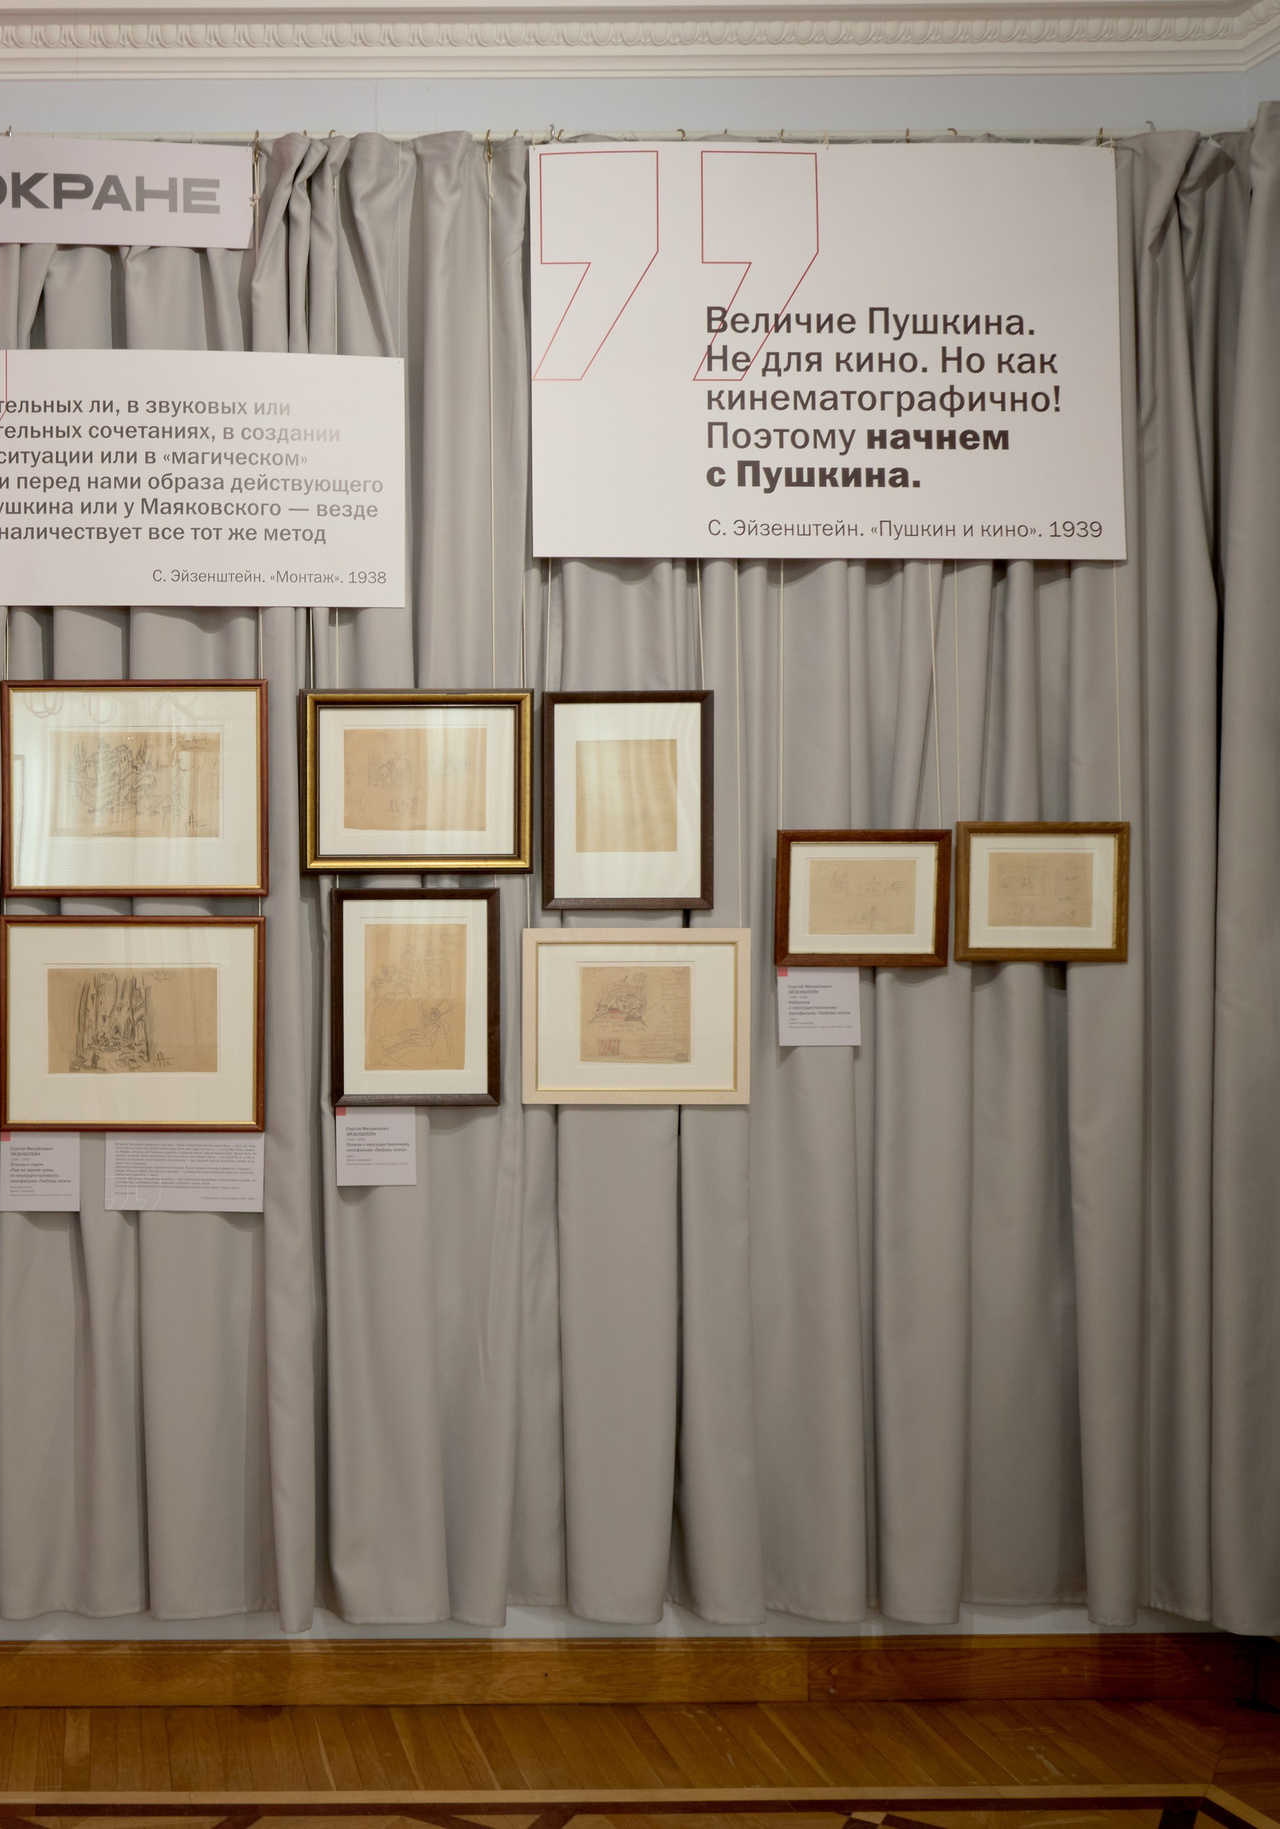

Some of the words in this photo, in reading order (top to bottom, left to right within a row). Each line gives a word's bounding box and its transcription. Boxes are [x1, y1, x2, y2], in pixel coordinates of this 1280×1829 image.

[706, 305, 857, 335] Величие
[868, 306, 1035, 342] Пушкина.
[706, 344, 752, 373] Не
[761, 351, 823, 378] для
[835, 351, 928, 374] кино.
[941, 345, 986, 374] Но
[997, 352, 1059, 375] как
[88, 399, 120, 417] ли,
[127, 400, 140, 414] в
[145, 400, 248, 418] звуковых
[254, 401, 290, 416] или
[706, 384, 1061, 419] кинематографично!
[88, 425, 216, 443] сочетаниях,
[223, 426, 235, 440] в
[240, 426, 340, 445] создании
[707, 421, 857, 457] Поэтому
[866, 428, 1010, 451] начнем
[100, 450, 138, 465] или
[144, 451, 157, 465] в
[16, 475, 81, 494] перед
[87, 475, 141, 490] нами
[147, 472, 225, 494] образа
[230, 473, 384, 496] действующего
[705, 466, 727, 488] с
[736, 459, 921, 495] Пушкина.
[80, 501, 118, 515] или
[123, 501, 135, 519] у
[140, 497, 282, 517] Маяковского
[316, 503, 379, 521] везде
[148, 526, 185, 541] все
[190, 527, 223, 541] тот
[227, 527, 258, 542] же
[263, 527, 327, 546] метод
[707, 518, 727, 536] С.
[733, 519, 864, 537] Эйзенштейн.
[963, 524, 974, 537] и
[980, 524, 1042, 538] кино».
[1049, 520, 1103, 538] 1939
[152, 569, 166, 583] С.
[170, 569, 266, 583] Эйзенштейн.
[348, 570, 387, 585] 1938
